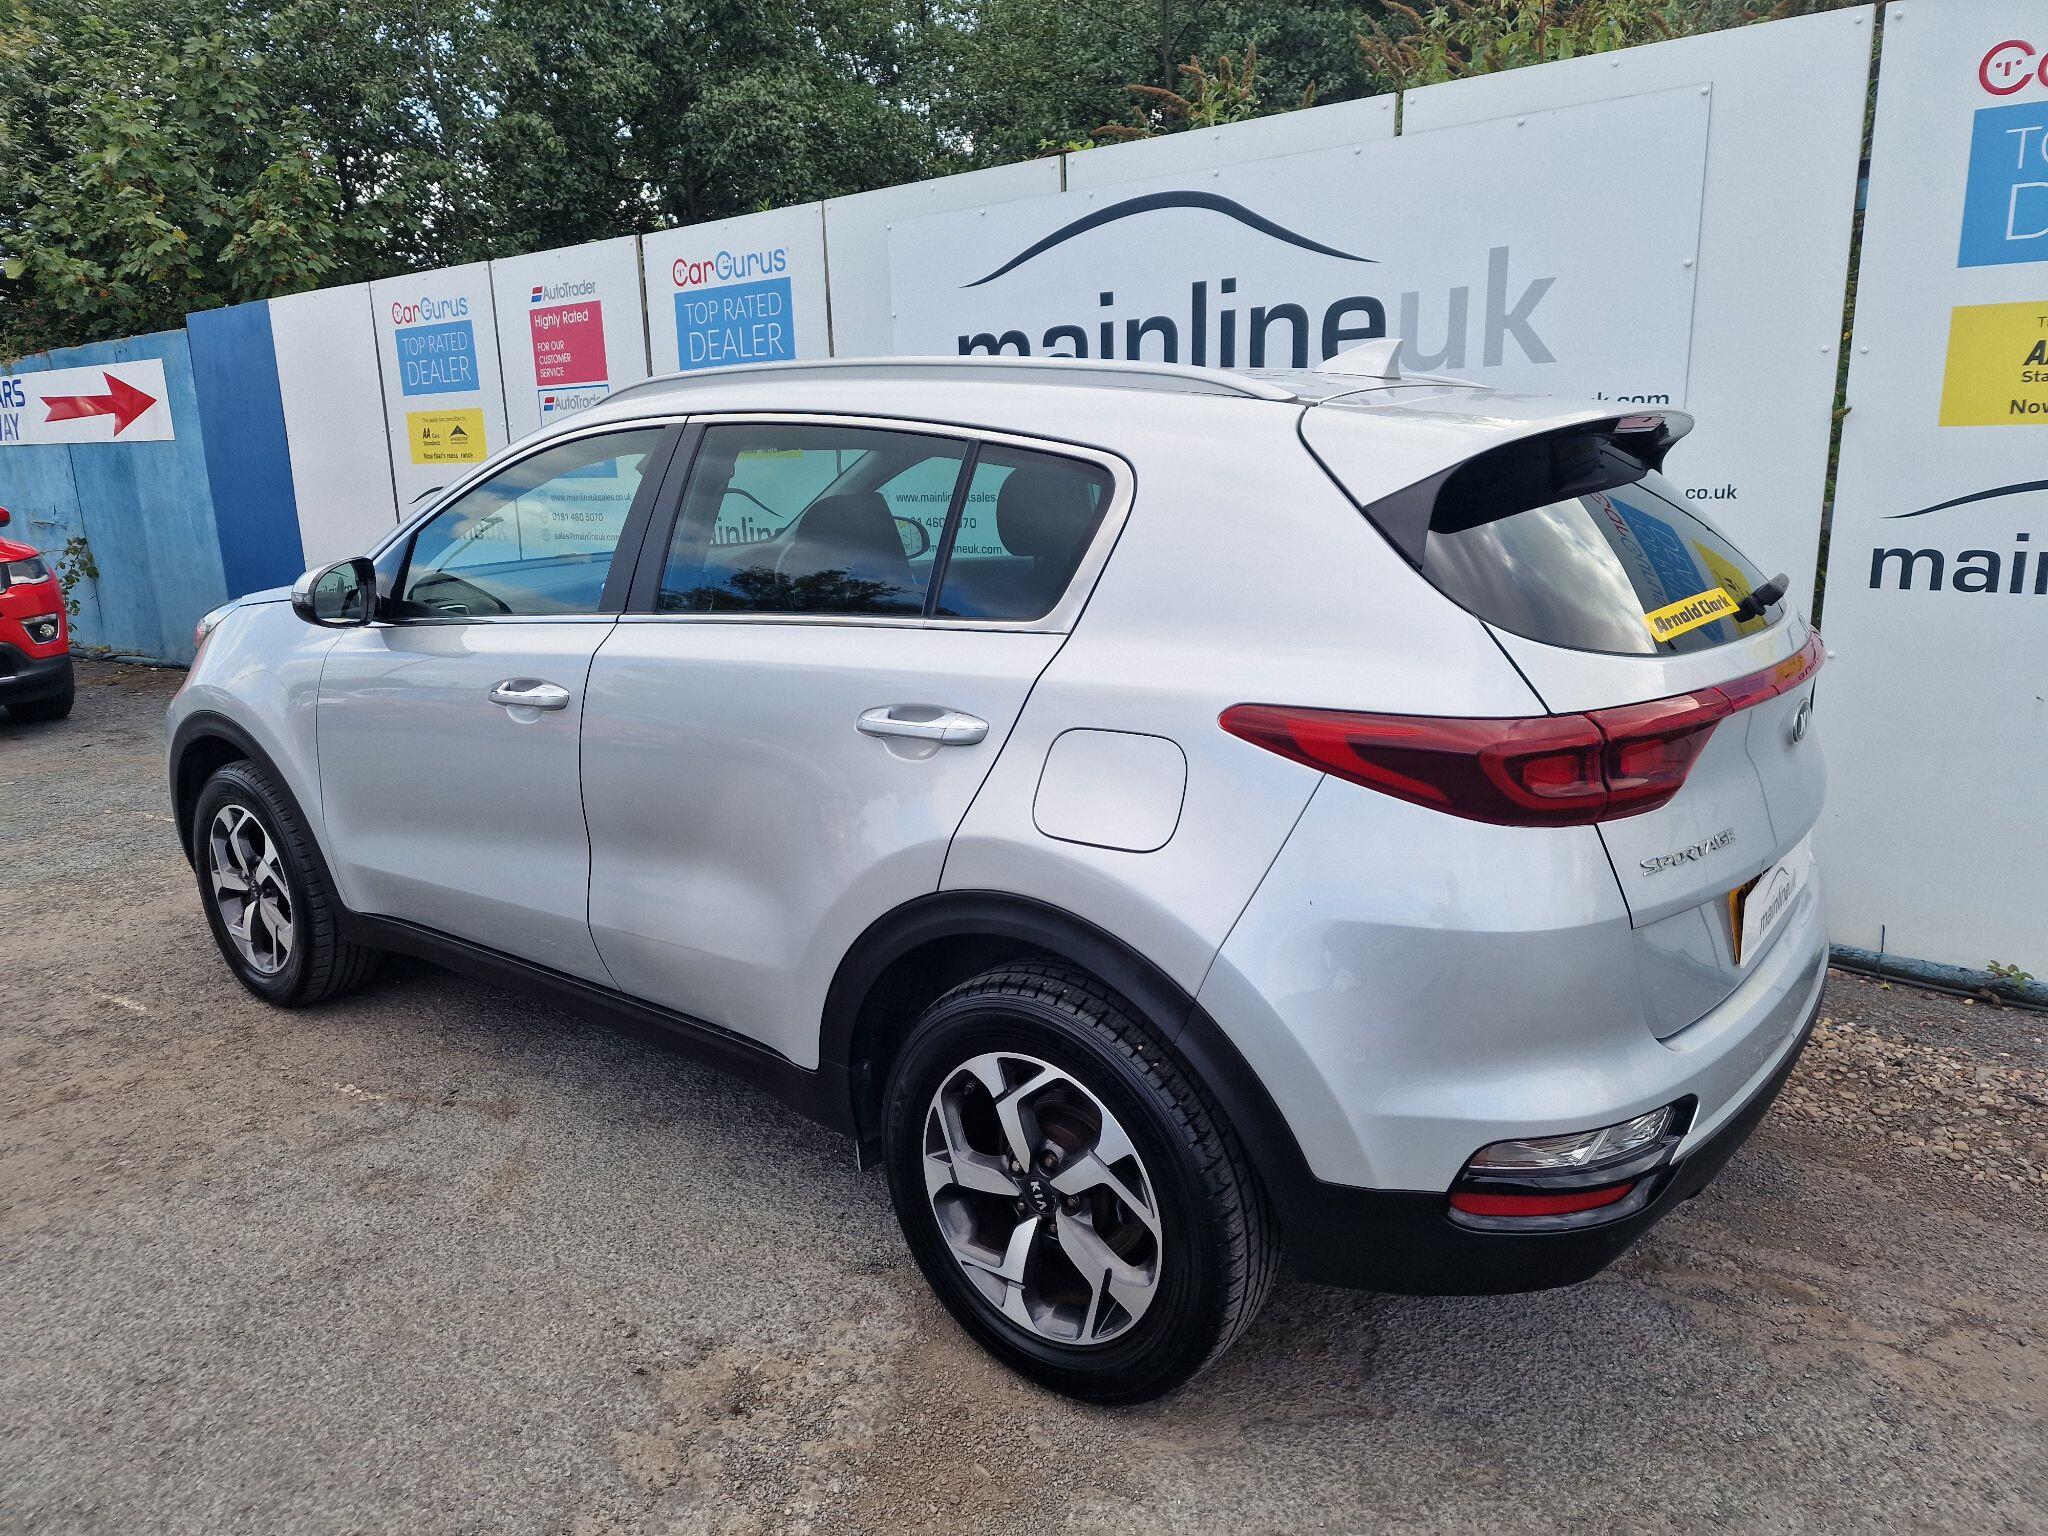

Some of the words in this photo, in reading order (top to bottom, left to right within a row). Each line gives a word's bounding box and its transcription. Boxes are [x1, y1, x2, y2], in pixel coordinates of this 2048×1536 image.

[1979, 39, 2048, 96] C
[2006, 125, 2048, 170] T
[673, 247, 787, 287] CarGurus
[543, 280, 597, 301] AutoTrader
[392, 296, 468, 325] CarGurus
[534, 313, 561, 330] Highly
[562, 308, 589, 325] Rated
[684, 301, 719, 325] TOP
[724, 291, 782, 321] RATED
[402, 336, 426, 356] TOP
[428, 331, 468, 354] RATED
[537, 341, 550, 352] FOR
[551, 339, 565, 351] OUR
[689, 322, 785, 362] DEALER
[407, 355, 472, 387] DEALER
[538, 352, 572, 365] CUSTOMER
[540, 366, 565, 378] SERVICE
[0, 379, 26, 409] RS
[0, 412, 20, 442] AY
[422, 427, 431, 439] AA
[570, 512, 585, 521] 460
[585, 512, 604, 521] 5070
[1653, 602, 1704, 634] Arnold
[1697, 594, 1733, 616] Clark
[1639, 827, 1737, 878] SPORTAGE
[1030, 1180, 1047, 1211] KIA
